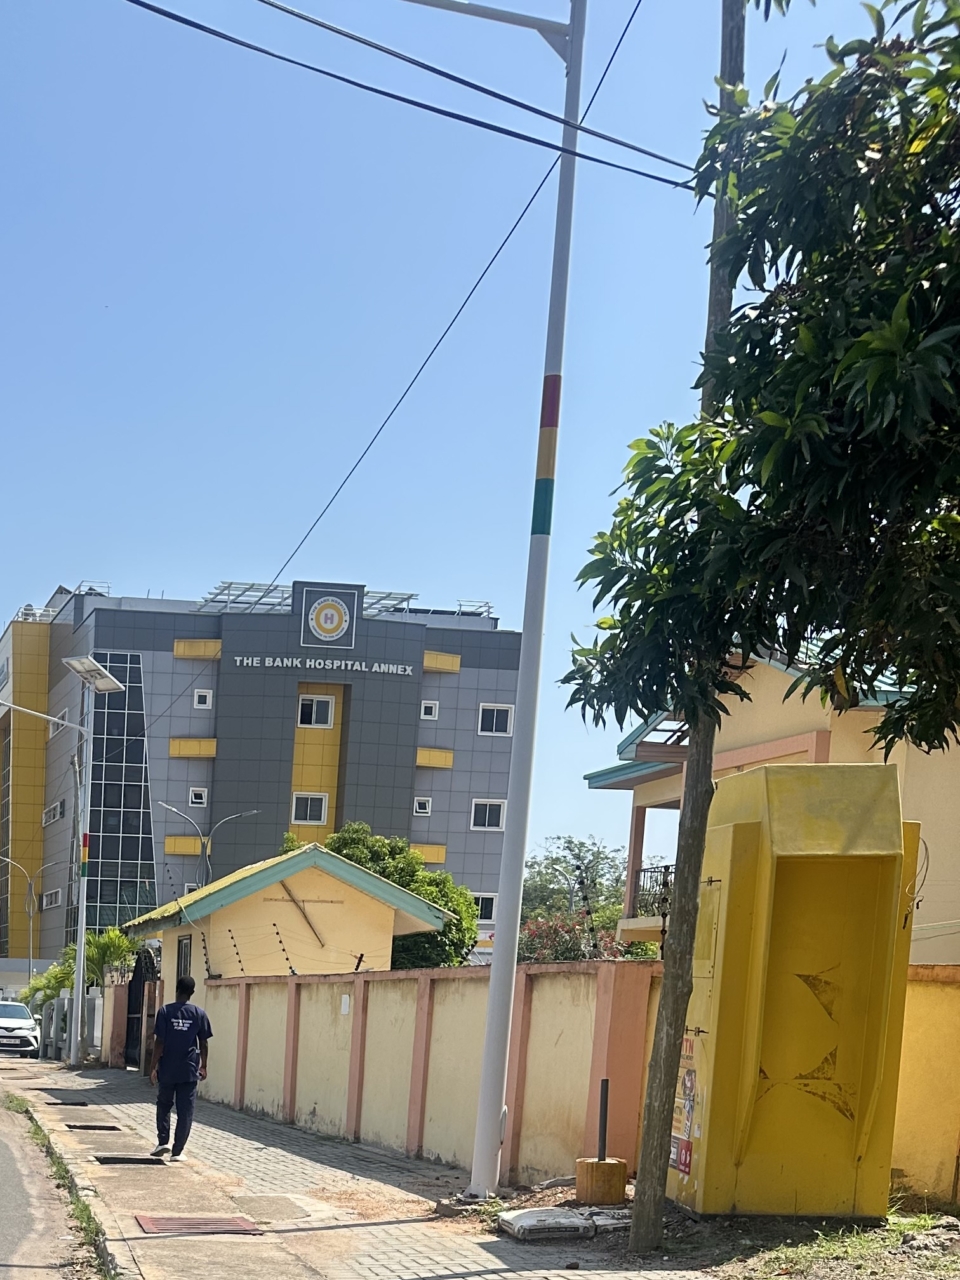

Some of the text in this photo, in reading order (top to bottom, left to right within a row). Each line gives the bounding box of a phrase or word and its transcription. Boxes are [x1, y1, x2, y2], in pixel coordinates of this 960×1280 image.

[324, 613, 334, 624] H
[234, 656, 413, 676] THE BANK HOSPITAL ANNEX
